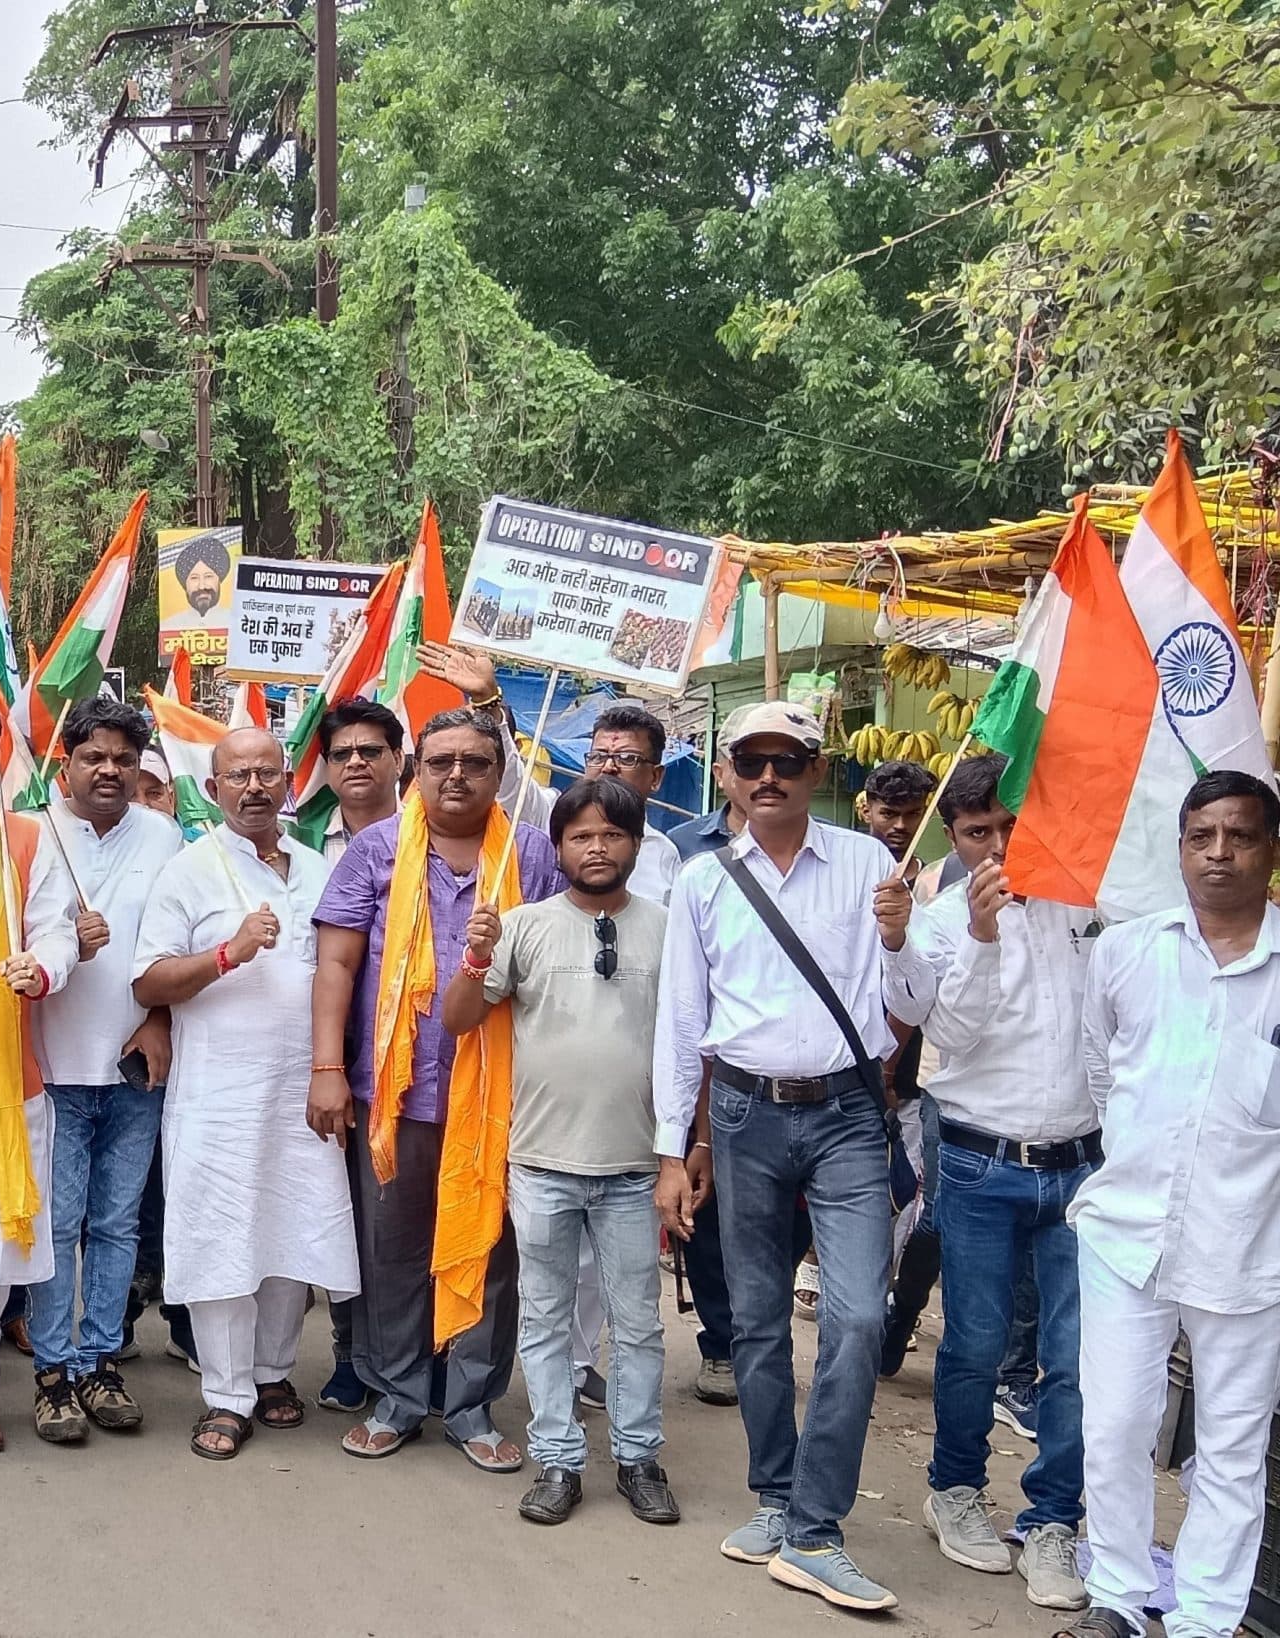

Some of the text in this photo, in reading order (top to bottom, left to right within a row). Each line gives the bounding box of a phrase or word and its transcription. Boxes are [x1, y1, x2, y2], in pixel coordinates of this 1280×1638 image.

[497, 512, 588, 553] OPERATION
[253, 571, 303, 591] OPERATION
[506, 558, 530, 577] अब
[532, 561, 559, 583] और
[589, 574, 630, 599] सहेगा
[631, 583, 668, 609] भारत,
[275, 603, 284, 613] का
[551, 590, 578, 611] पाक
[241, 614, 261, 635] देश
[263, 616, 279, 636] की
[305, 618, 314, 639] है
[536, 610, 615, 642] करेगा भारत
[163, 628, 228, 653] मोंगिय
[249, 639, 303, 663] एक पुकार
[190, 652, 227, 666] टील
